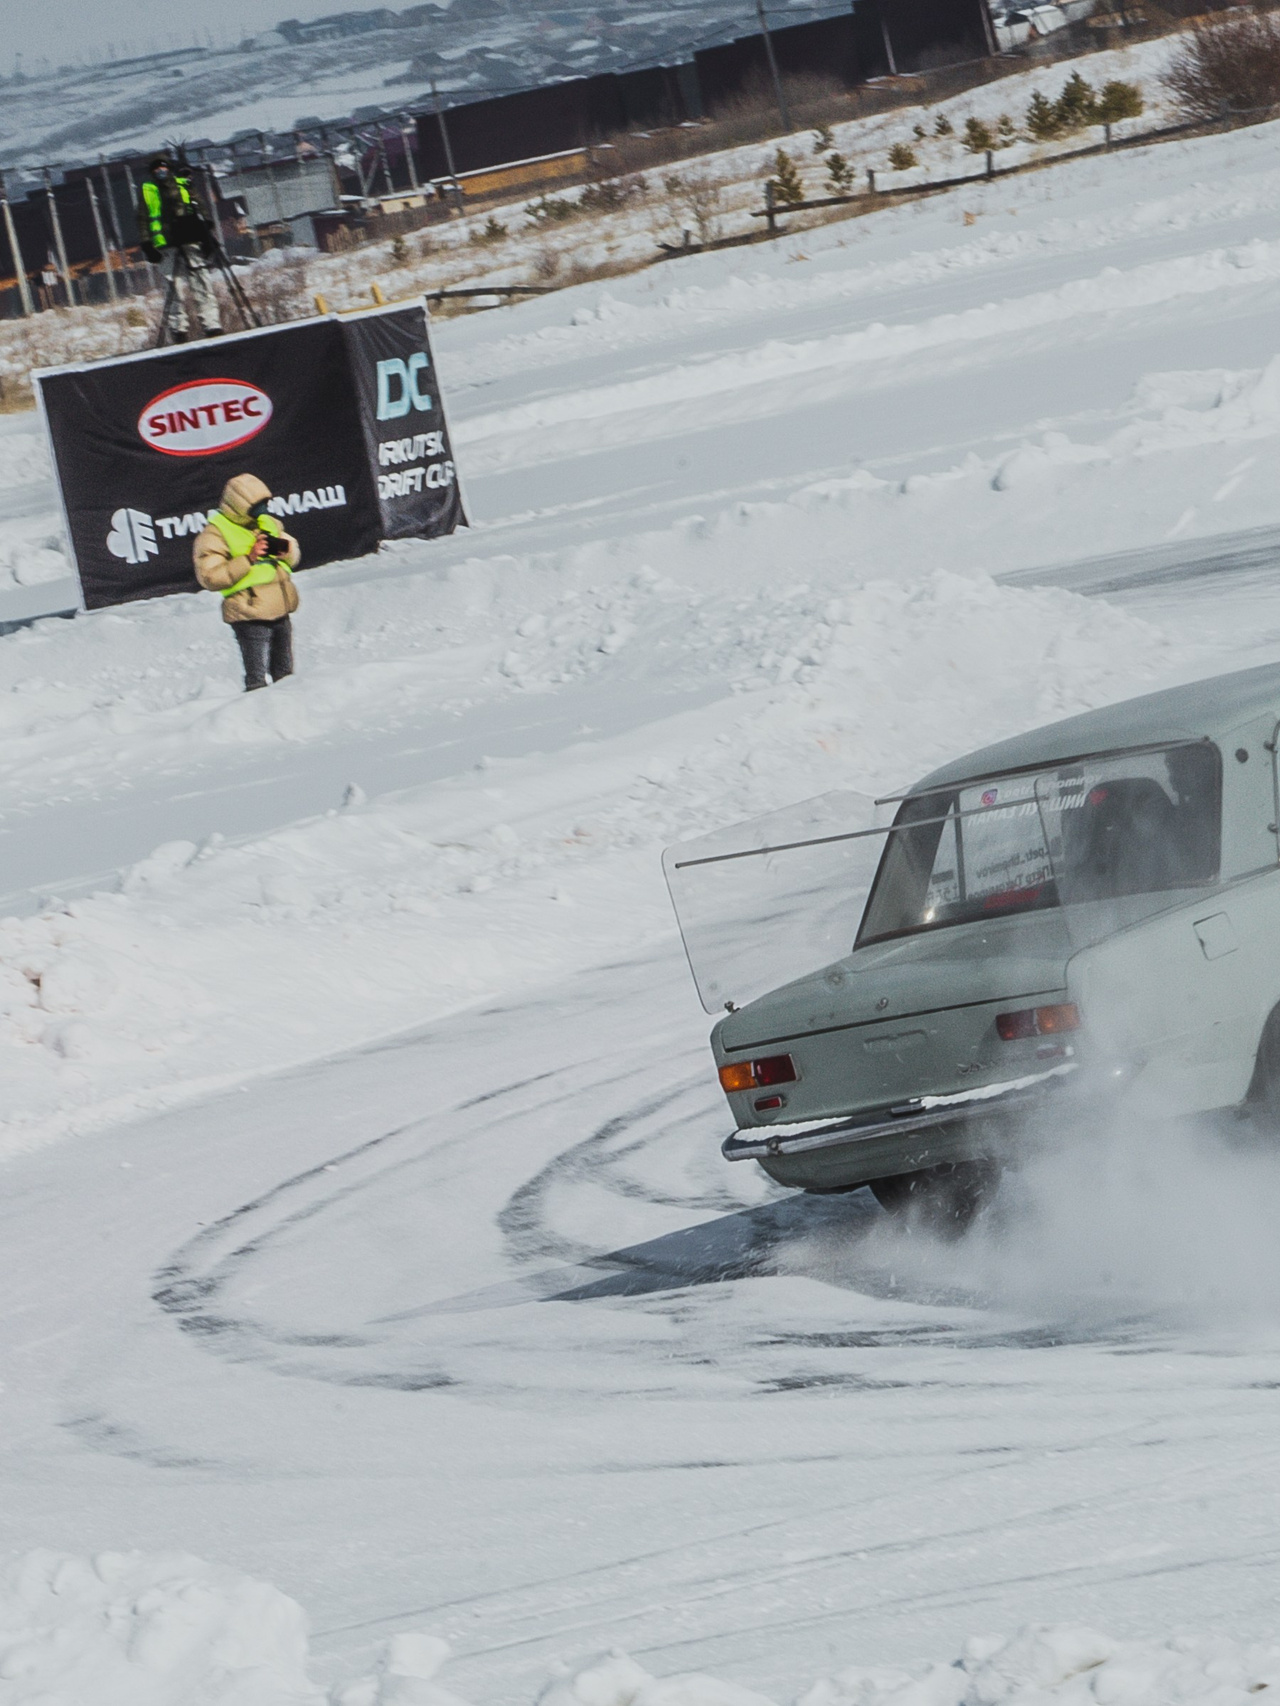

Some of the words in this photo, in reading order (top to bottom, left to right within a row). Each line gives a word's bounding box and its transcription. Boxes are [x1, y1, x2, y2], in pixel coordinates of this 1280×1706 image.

[377, 352, 432, 421] DC
[148, 395, 262, 437] SINTEC
[378, 430, 445, 466] IRKUTSK
[377, 467, 425, 500] DRIFT
[425, 460, 455, 489] CUP
